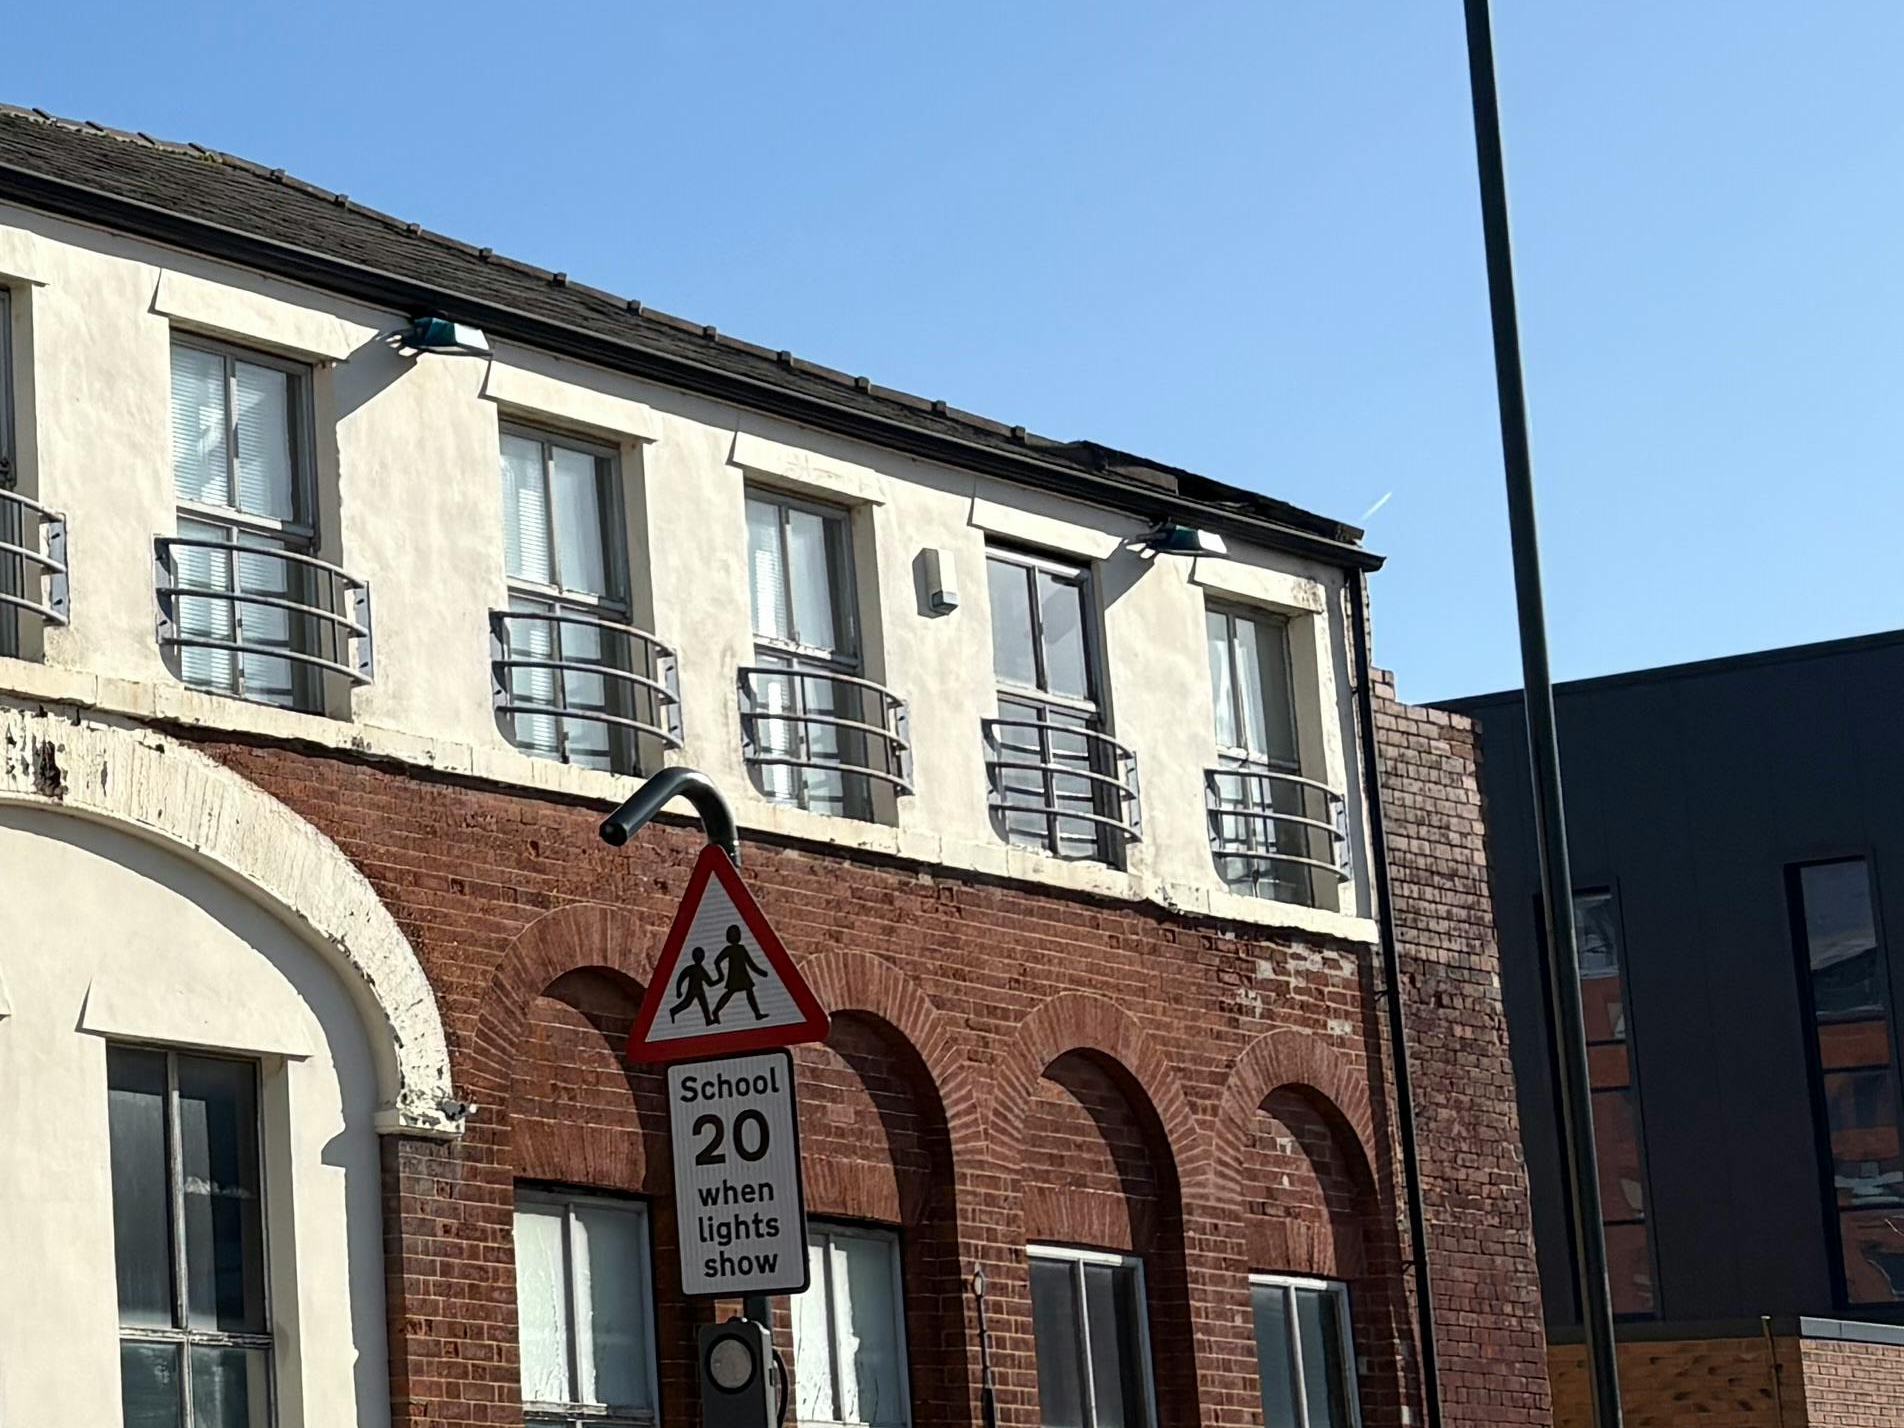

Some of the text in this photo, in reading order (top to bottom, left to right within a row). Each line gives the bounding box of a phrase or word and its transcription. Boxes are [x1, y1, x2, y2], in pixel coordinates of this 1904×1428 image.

[680, 1067, 780, 1103] School
[691, 1108, 770, 1166] 20
[698, 1179, 774, 1207] when
[698, 1212, 780, 1246] lights
[703, 1249, 779, 1278] show
